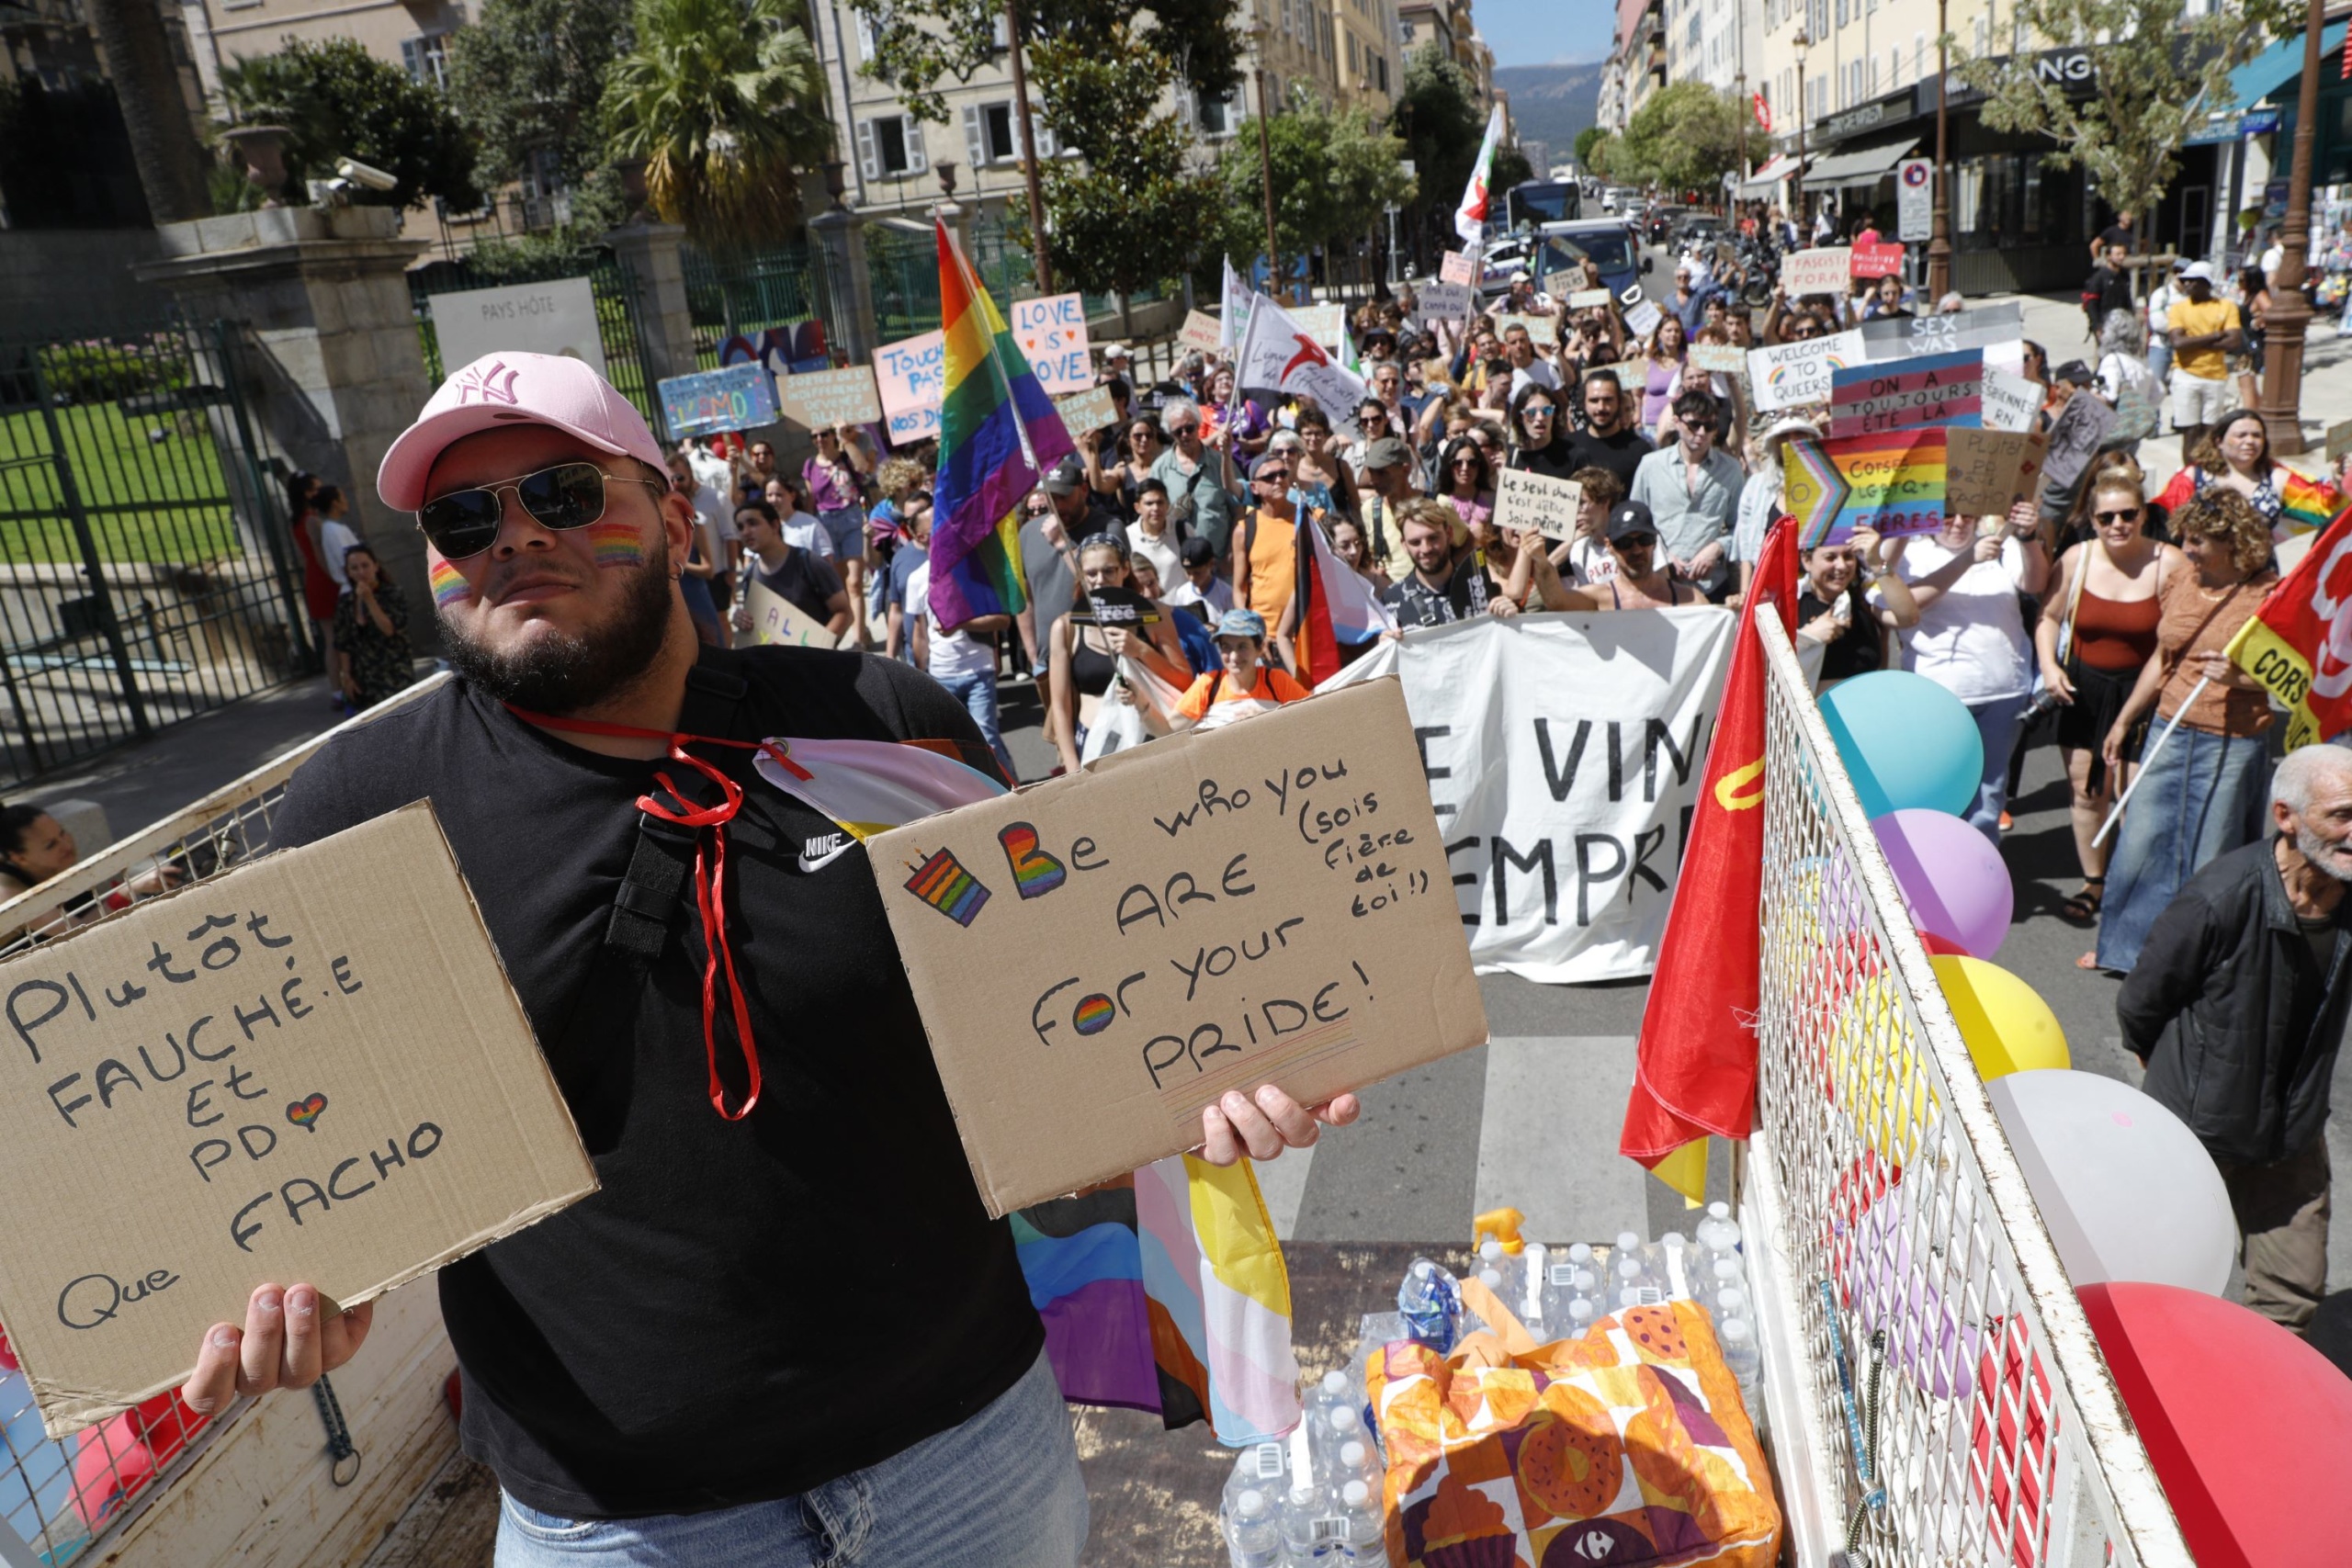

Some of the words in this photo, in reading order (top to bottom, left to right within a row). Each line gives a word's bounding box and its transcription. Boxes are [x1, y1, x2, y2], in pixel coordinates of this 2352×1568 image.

[481, 304, 515, 321] PAYS
[518, 296, 555, 317] HÔTE
[1021, 299, 1082, 330] LOVE
[1911, 315, 1957, 337] SEX
[1768, 339, 1842, 364] WELCOME
[1907, 334, 1957, 354] WAS
[1026, 351, 1087, 382] OVE
[1792, 362, 1817, 378] TO
[1870, 377, 1900, 398] ON
[1924, 366, 1939, 388] A
[1774, 377, 1830, 401] QUEERS
[1849, 382, 1972, 415] TOUJOURS
[891, 412, 920, 435] NOS
[1995, 408, 2015, 427] RN
[1503, 473, 1517, 491] Le
[2254, 647, 2310, 705] CORS
[1533, 713, 1715, 803] VIN
[806, 831, 842, 857] NIKE
[998, 821, 1109, 900] Be
[1154, 778, 1251, 837] who
[1264, 758, 1348, 818] you
[1354, 862, 1396, 885] de
[1445, 805, 1693, 926] EMPR
[1115, 853, 1255, 936] ARE
[4, 911, 292, 1063] Plutôt
[187, 1066, 268, 1128] Et
[189, 1124, 277, 1182] PD
[57, 1268, 180, 1329] Que
[230, 1121, 444, 1253] FACHO
